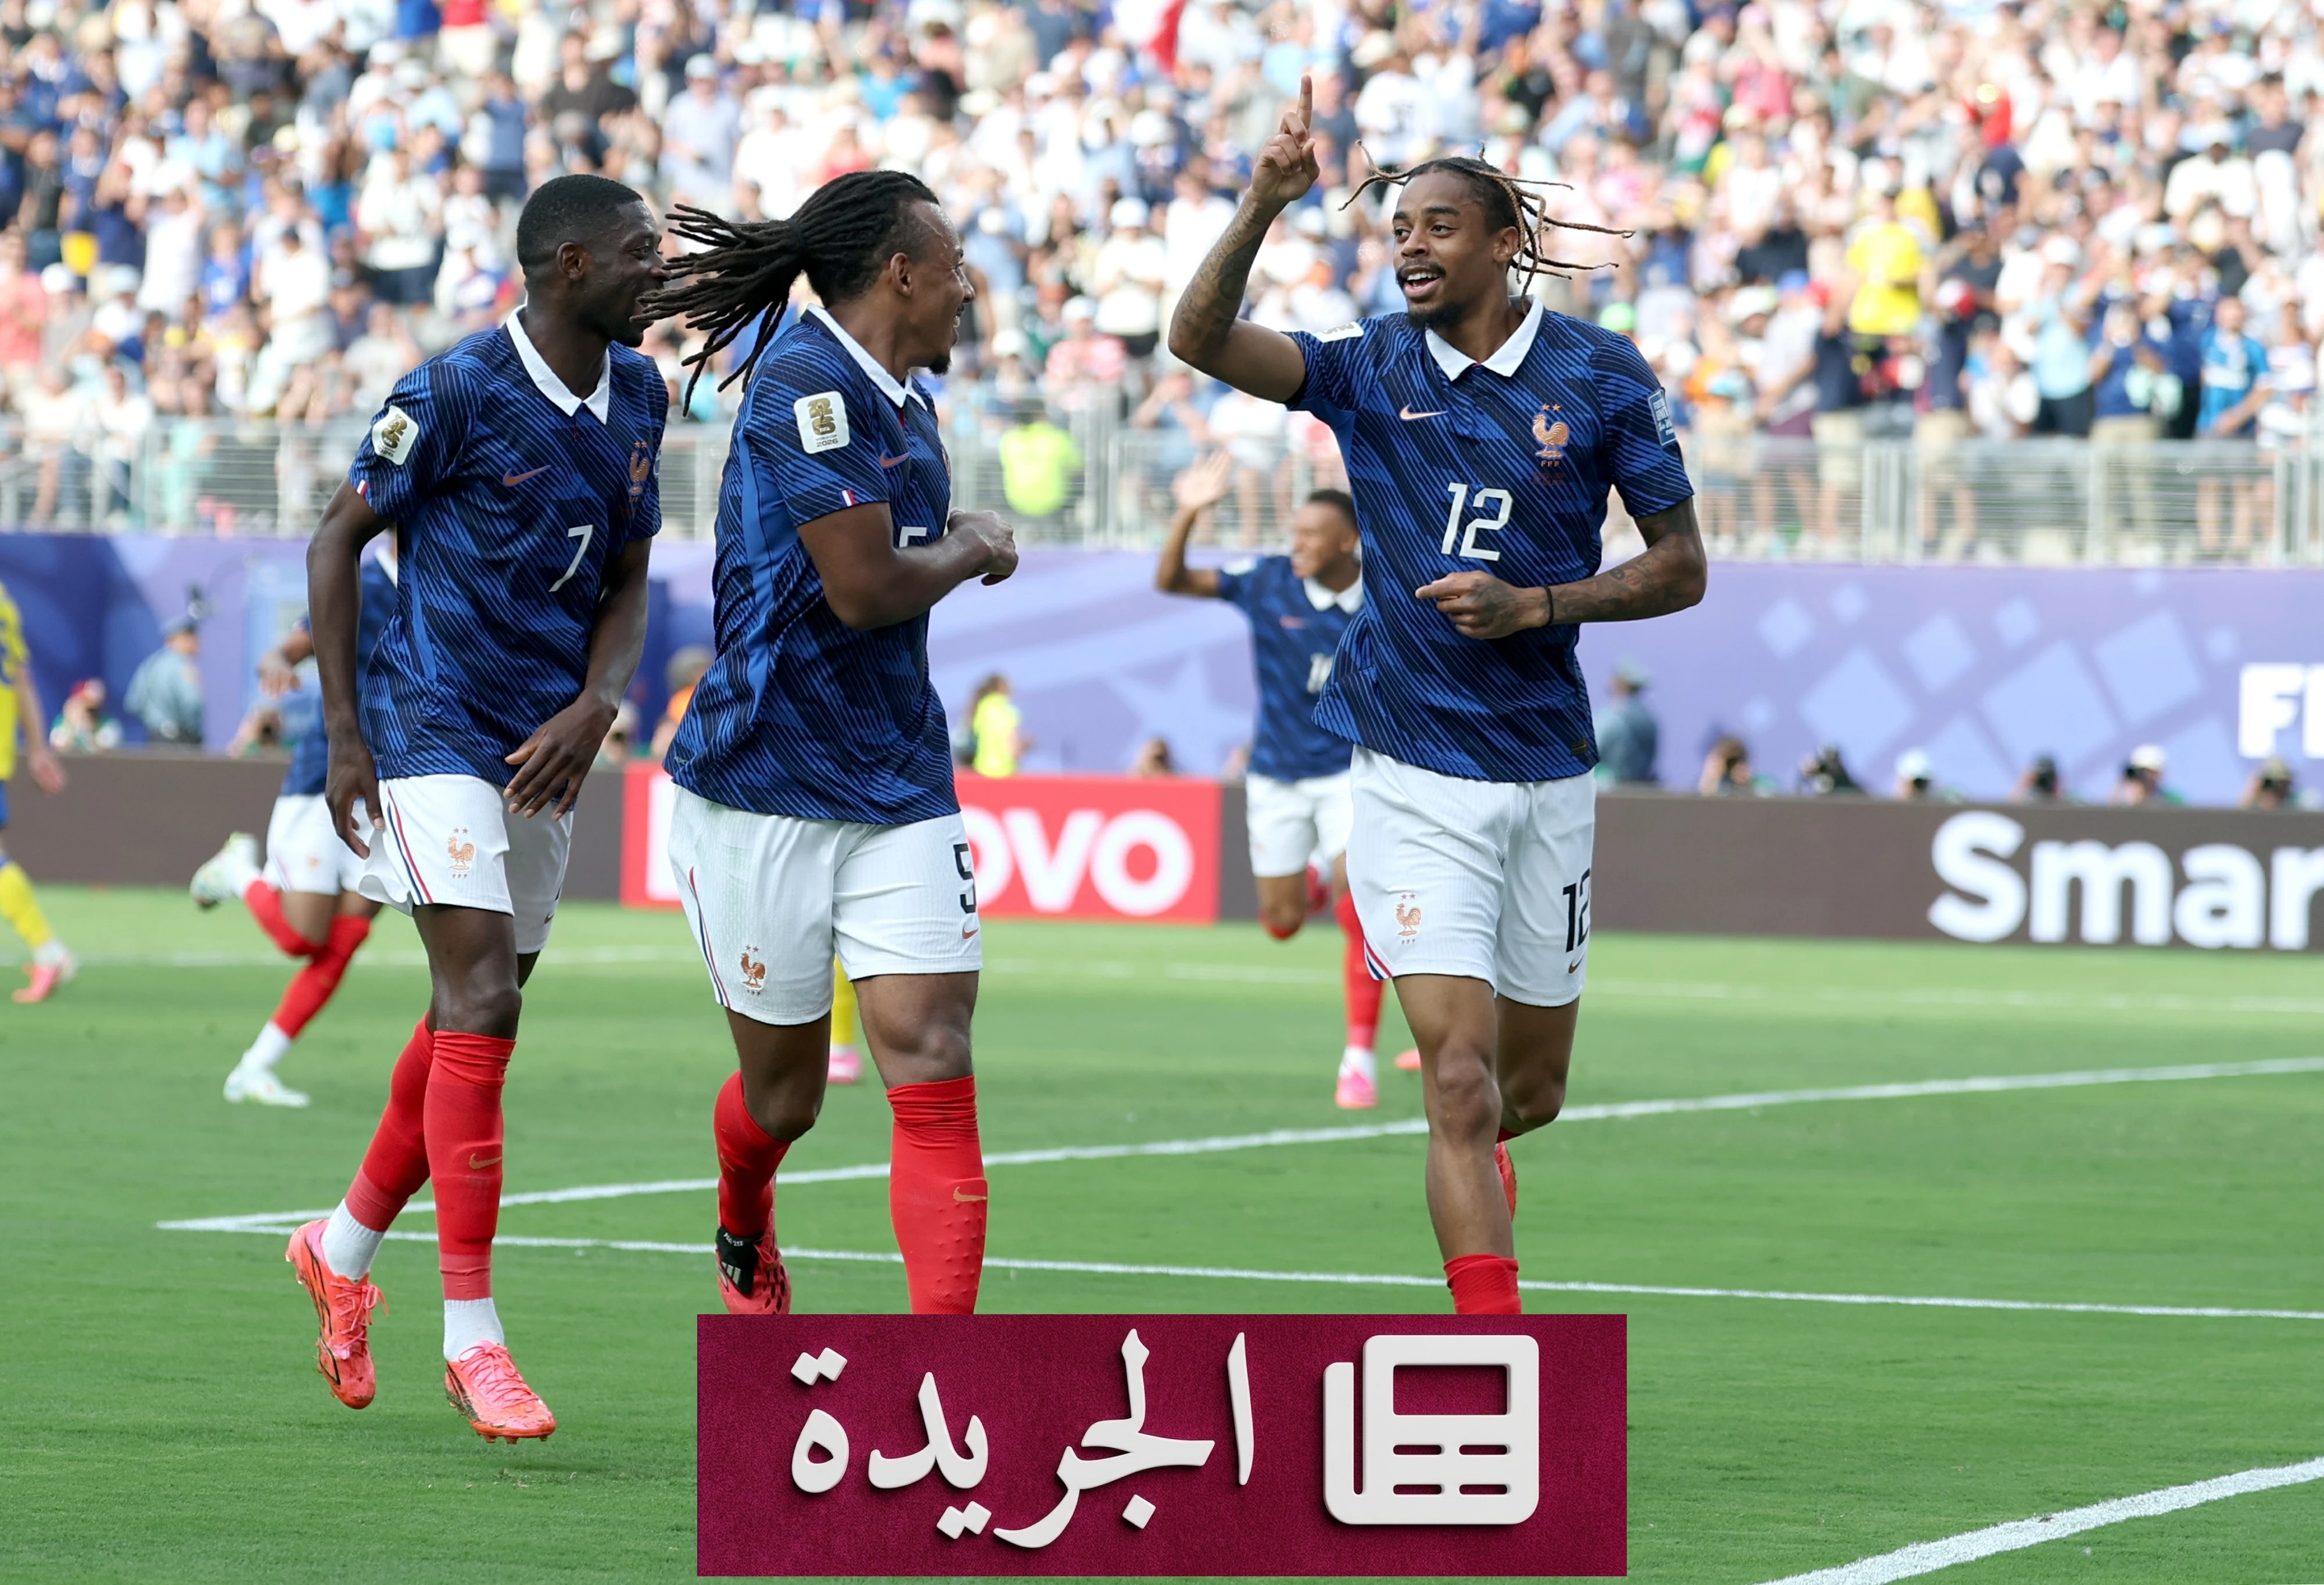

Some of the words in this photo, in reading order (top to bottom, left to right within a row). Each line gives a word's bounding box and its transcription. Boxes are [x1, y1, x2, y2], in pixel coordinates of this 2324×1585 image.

[816, 438, 839, 448] 2026
[1440, 482, 1513, 562] 12
[548, 524, 593, 593] 7
[953, 842, 977, 914] 5
[1562, 867, 1590, 953] 12
